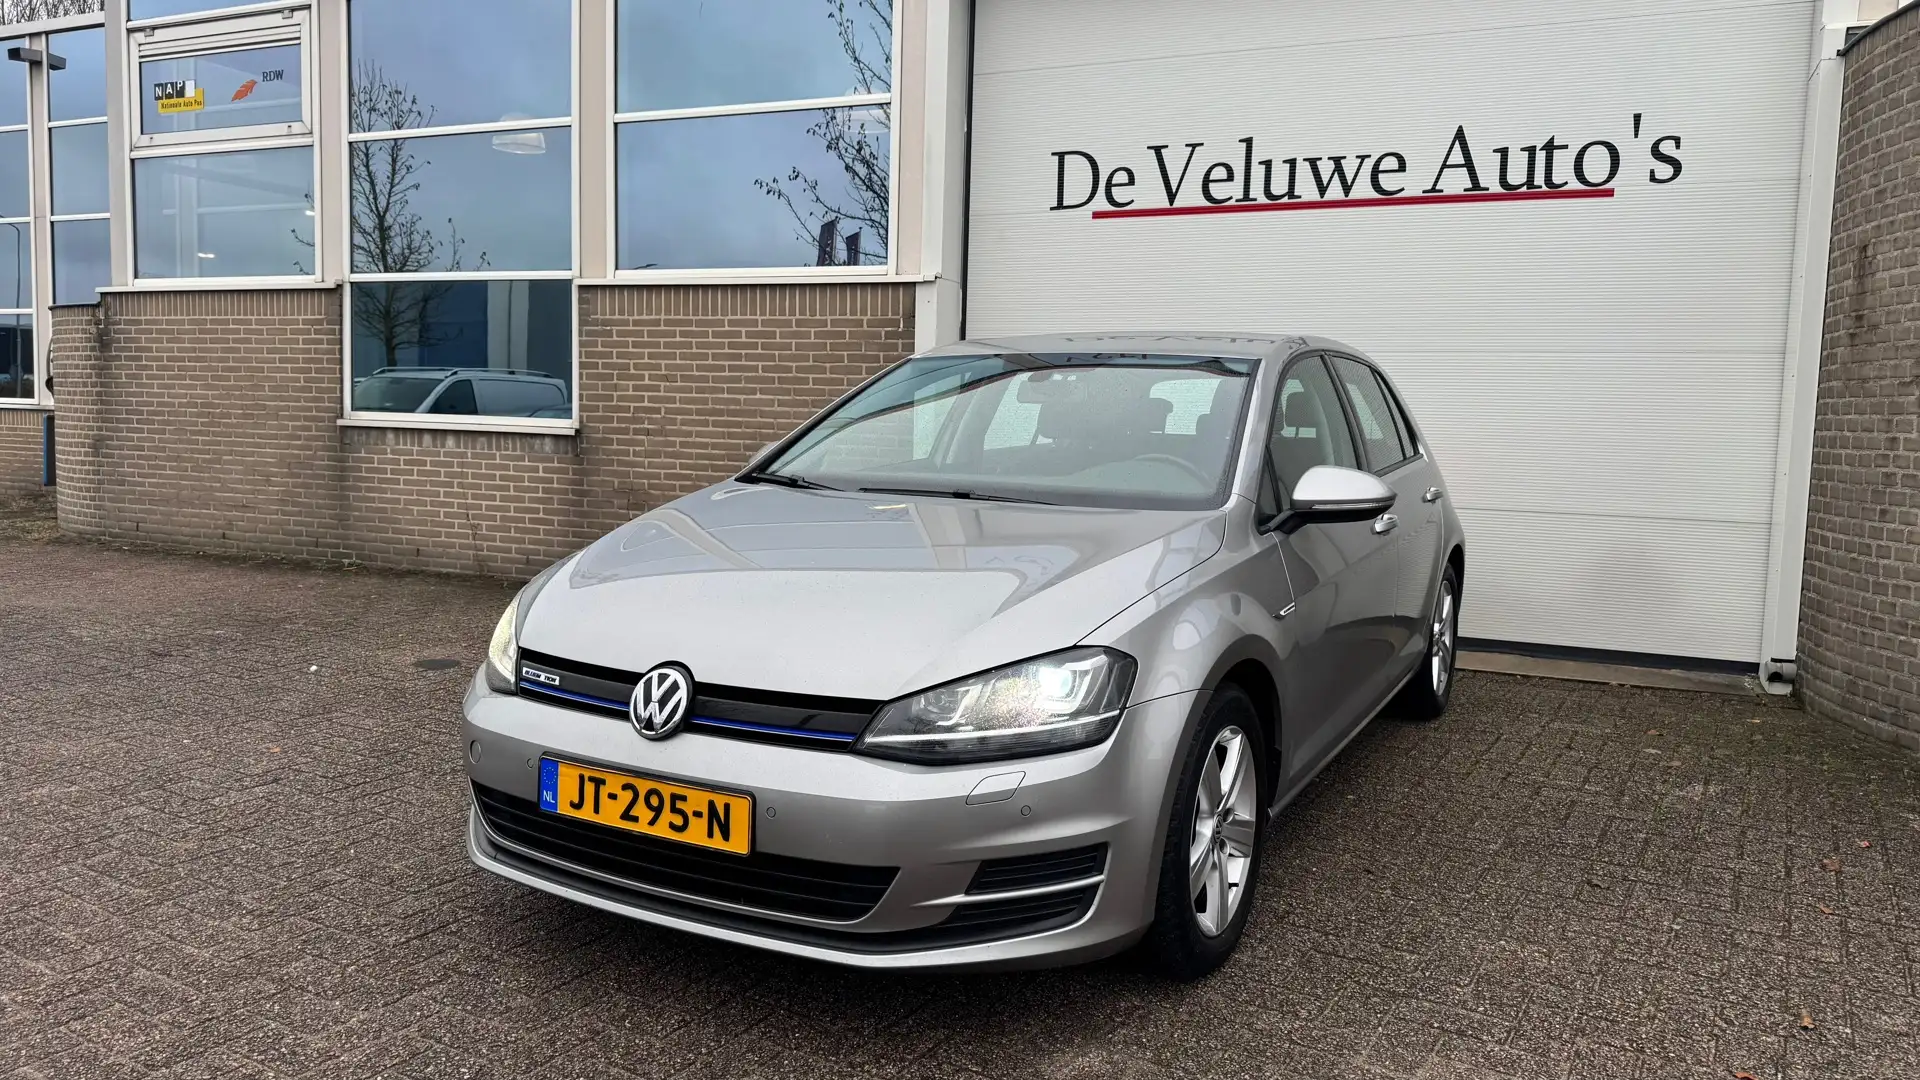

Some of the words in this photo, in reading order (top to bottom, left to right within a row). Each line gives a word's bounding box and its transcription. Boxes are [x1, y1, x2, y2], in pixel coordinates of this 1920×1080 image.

[155, 80, 183, 97] NAP
[262, 69, 284, 82] RDW
[194, 99, 203, 107] Pas
[1049, 149, 1136, 211] De
[1146, 136, 1408, 208] Veluwe
[1422, 112, 1684, 194] Auto's
[631, 668, 687, 736] VW
[542, 789, 556, 804] NL
[569, 772, 731, 842] JT-295-N
